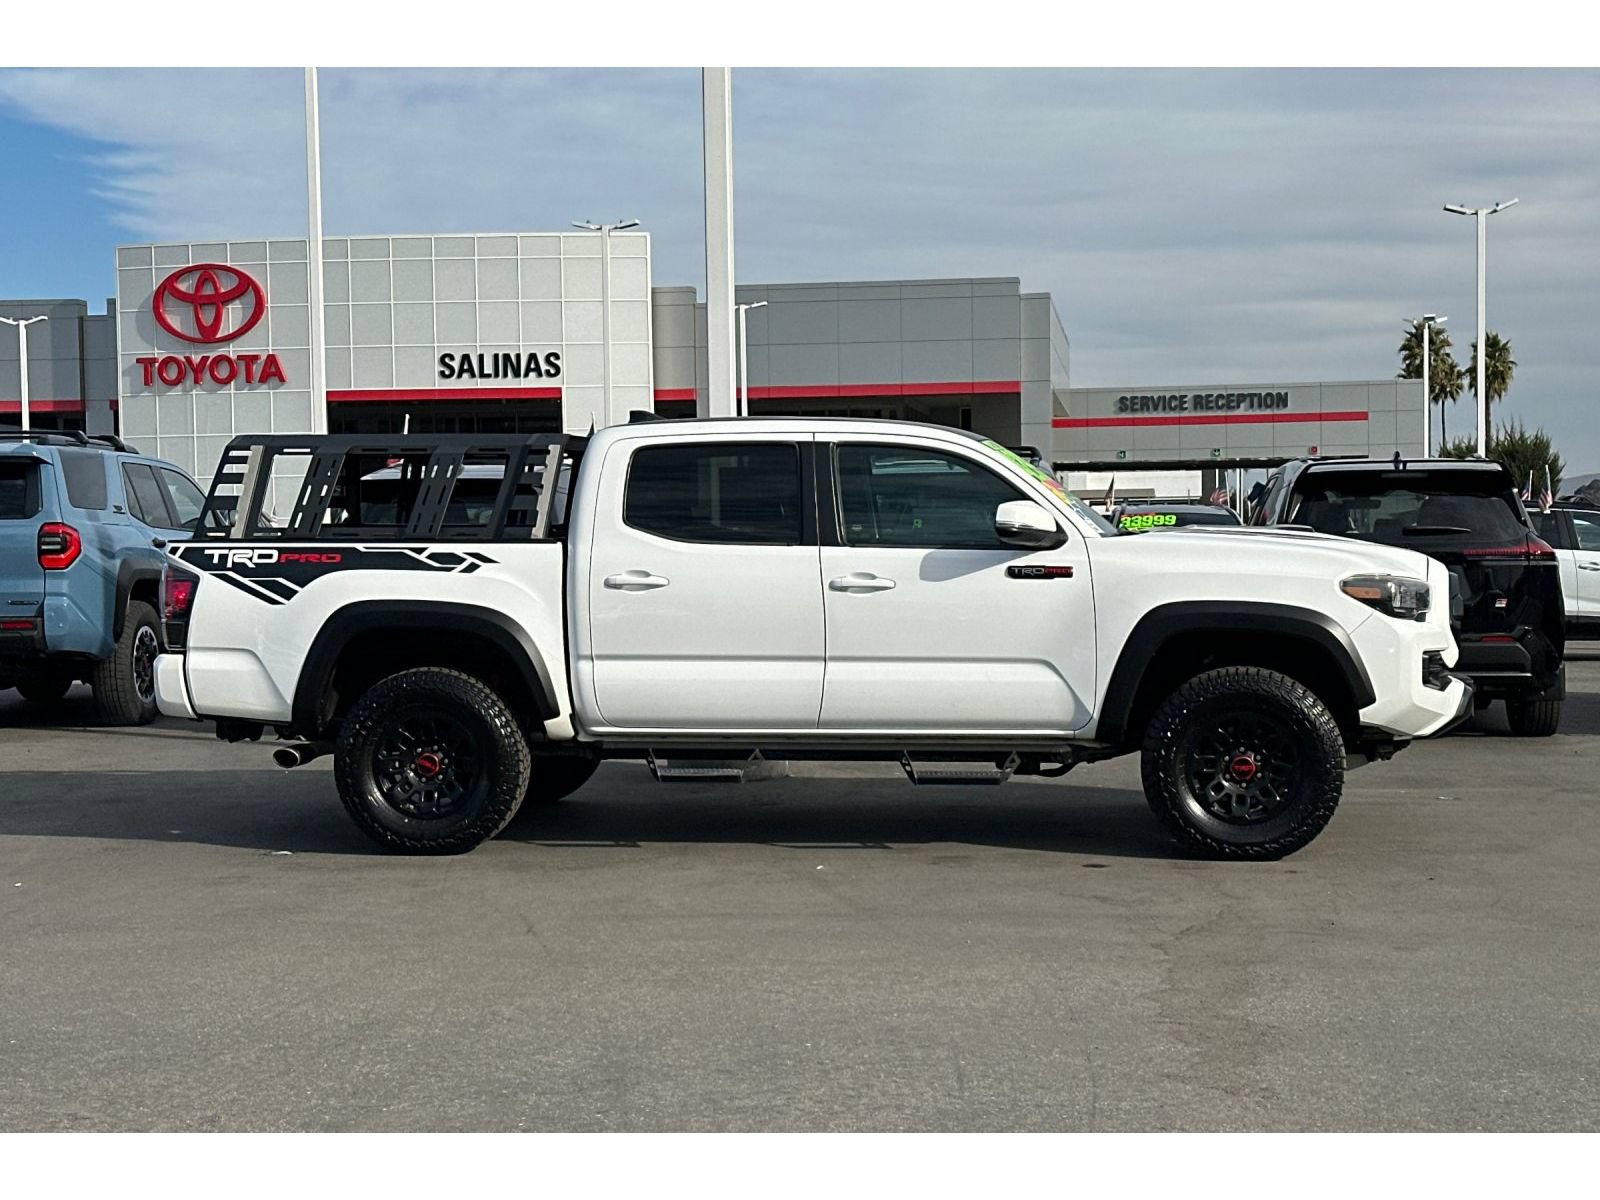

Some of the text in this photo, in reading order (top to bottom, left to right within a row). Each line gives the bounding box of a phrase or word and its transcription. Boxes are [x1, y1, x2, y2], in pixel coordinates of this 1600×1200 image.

[136, 353, 287, 386] TOYOTA
[438, 352, 561, 379] SALINAS
[1117, 391, 1289, 413] SERVICE RECEPTION
